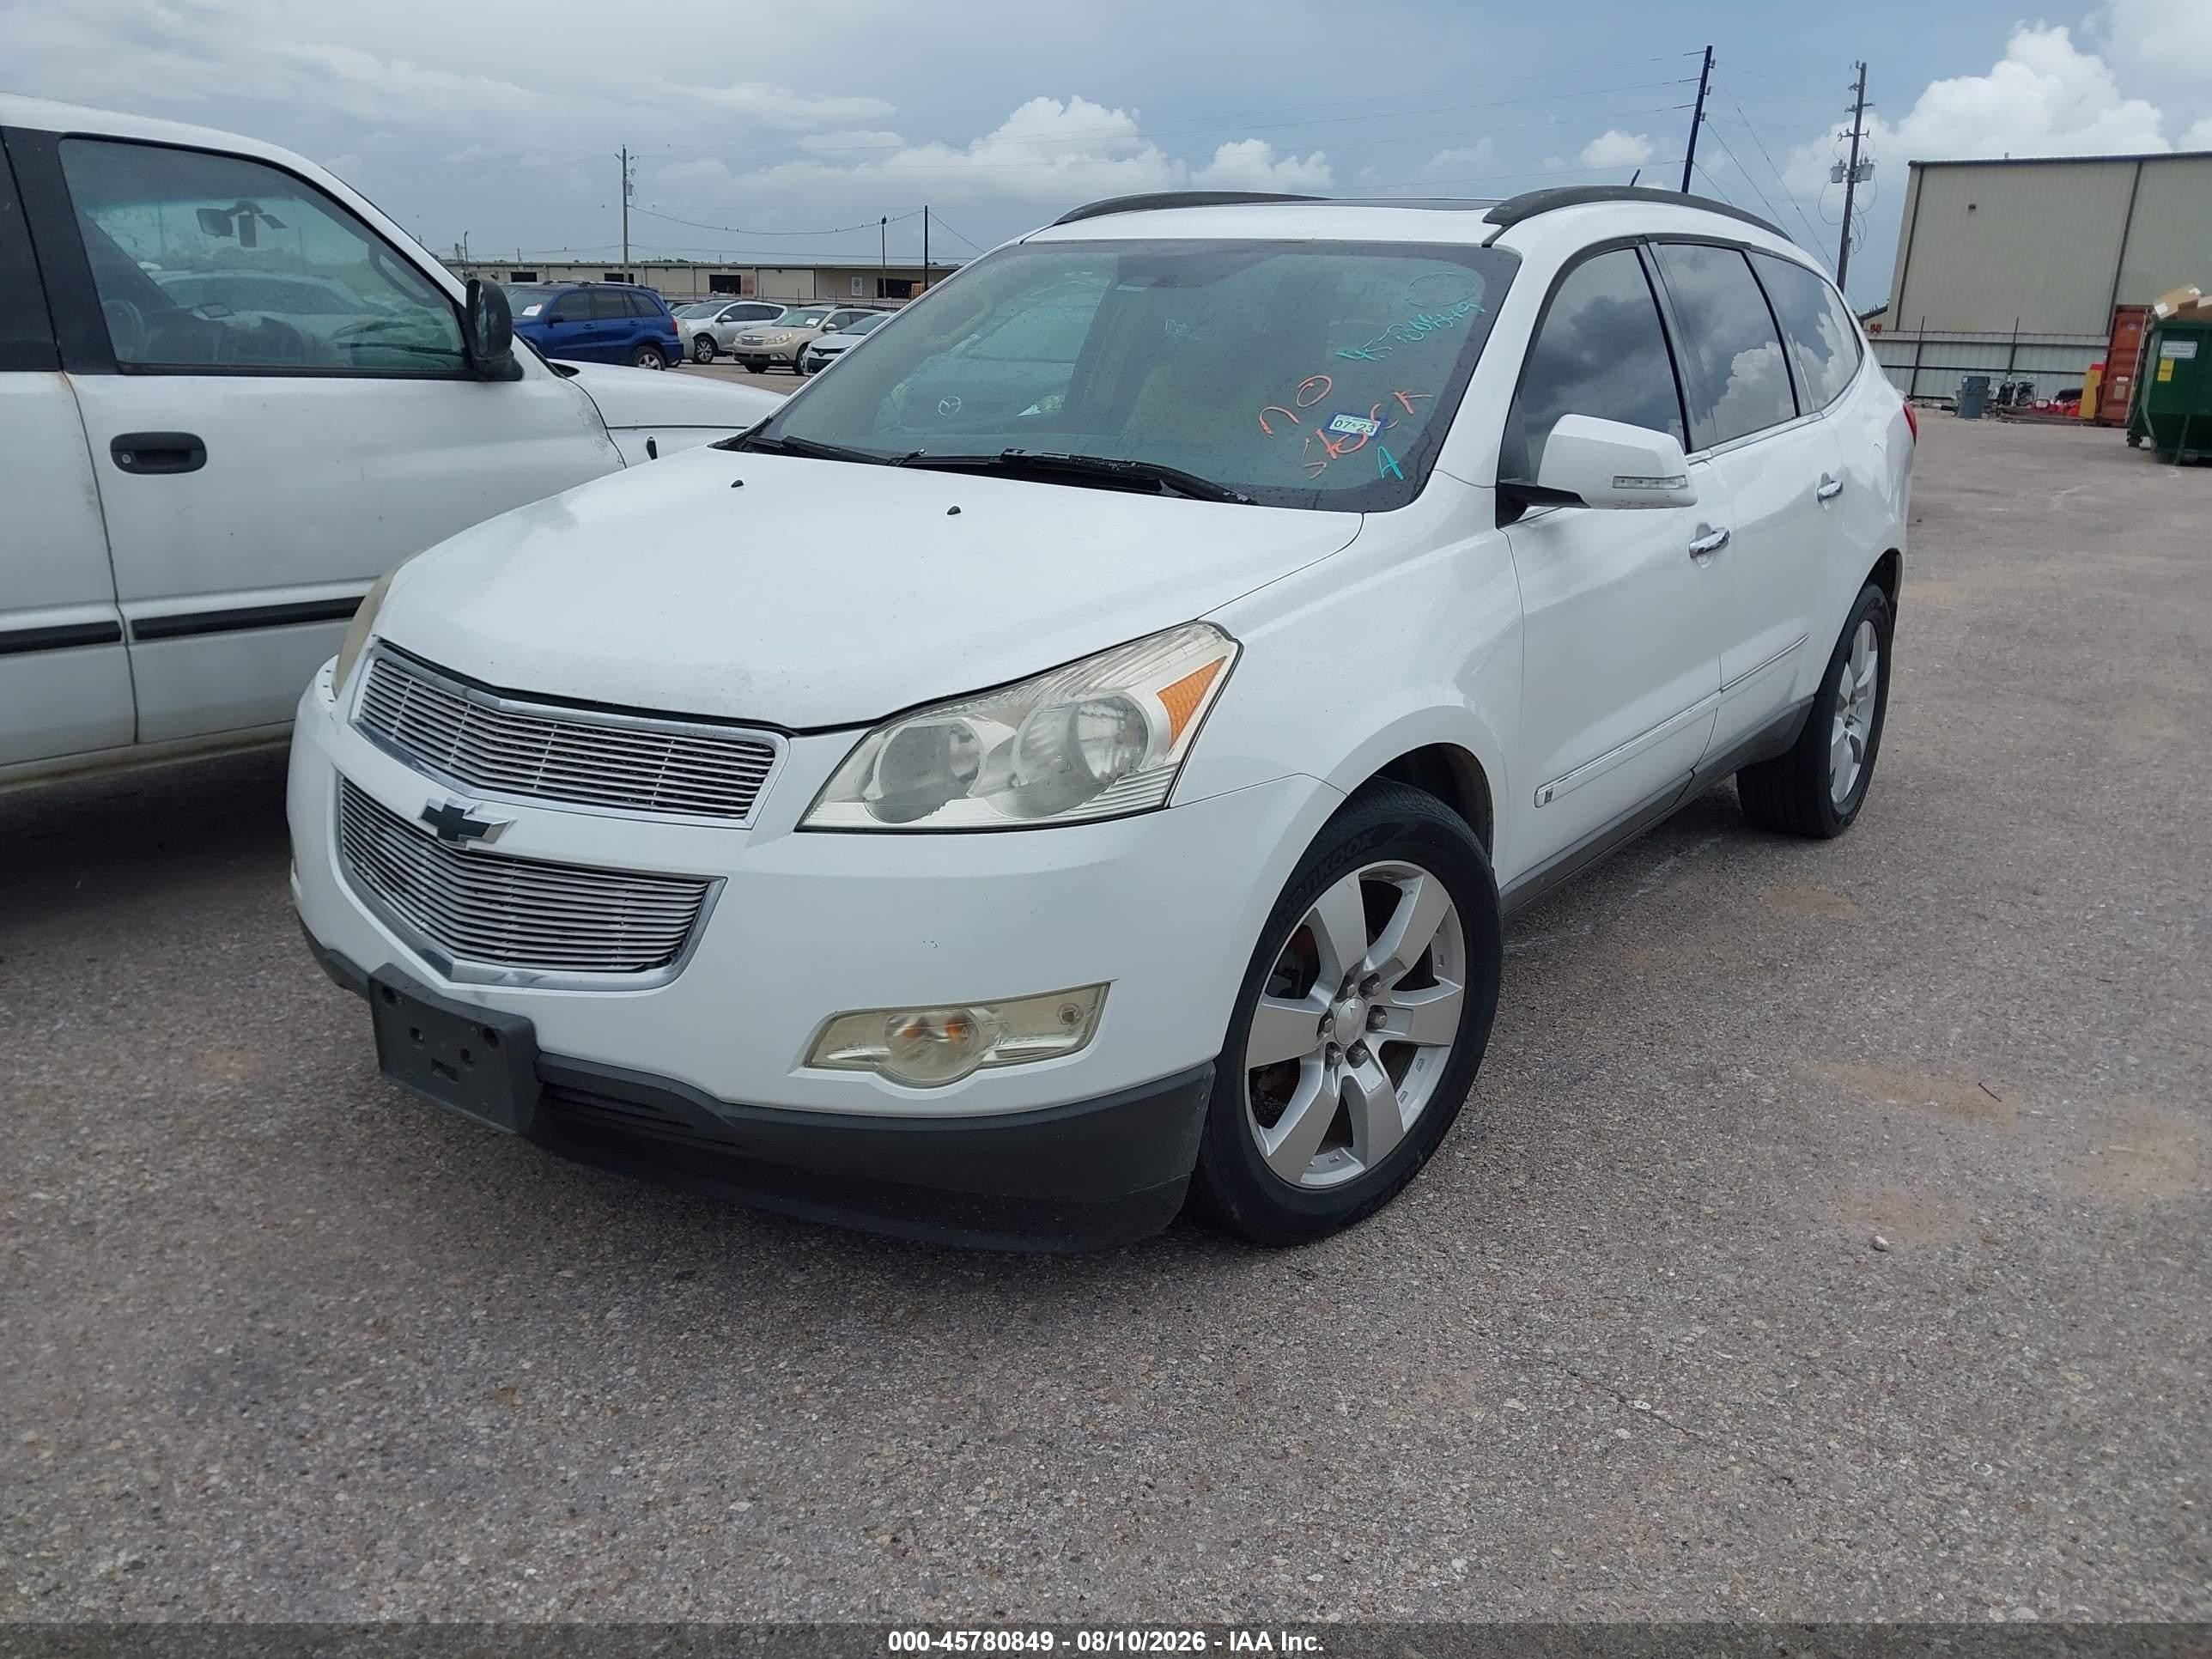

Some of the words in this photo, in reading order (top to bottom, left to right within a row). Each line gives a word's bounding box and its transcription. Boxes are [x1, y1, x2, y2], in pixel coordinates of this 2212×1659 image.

[1334, 419, 1352, 429] 07
[1356, 423, 1375, 434] 23
[1377, 446, 1404, 480] A
